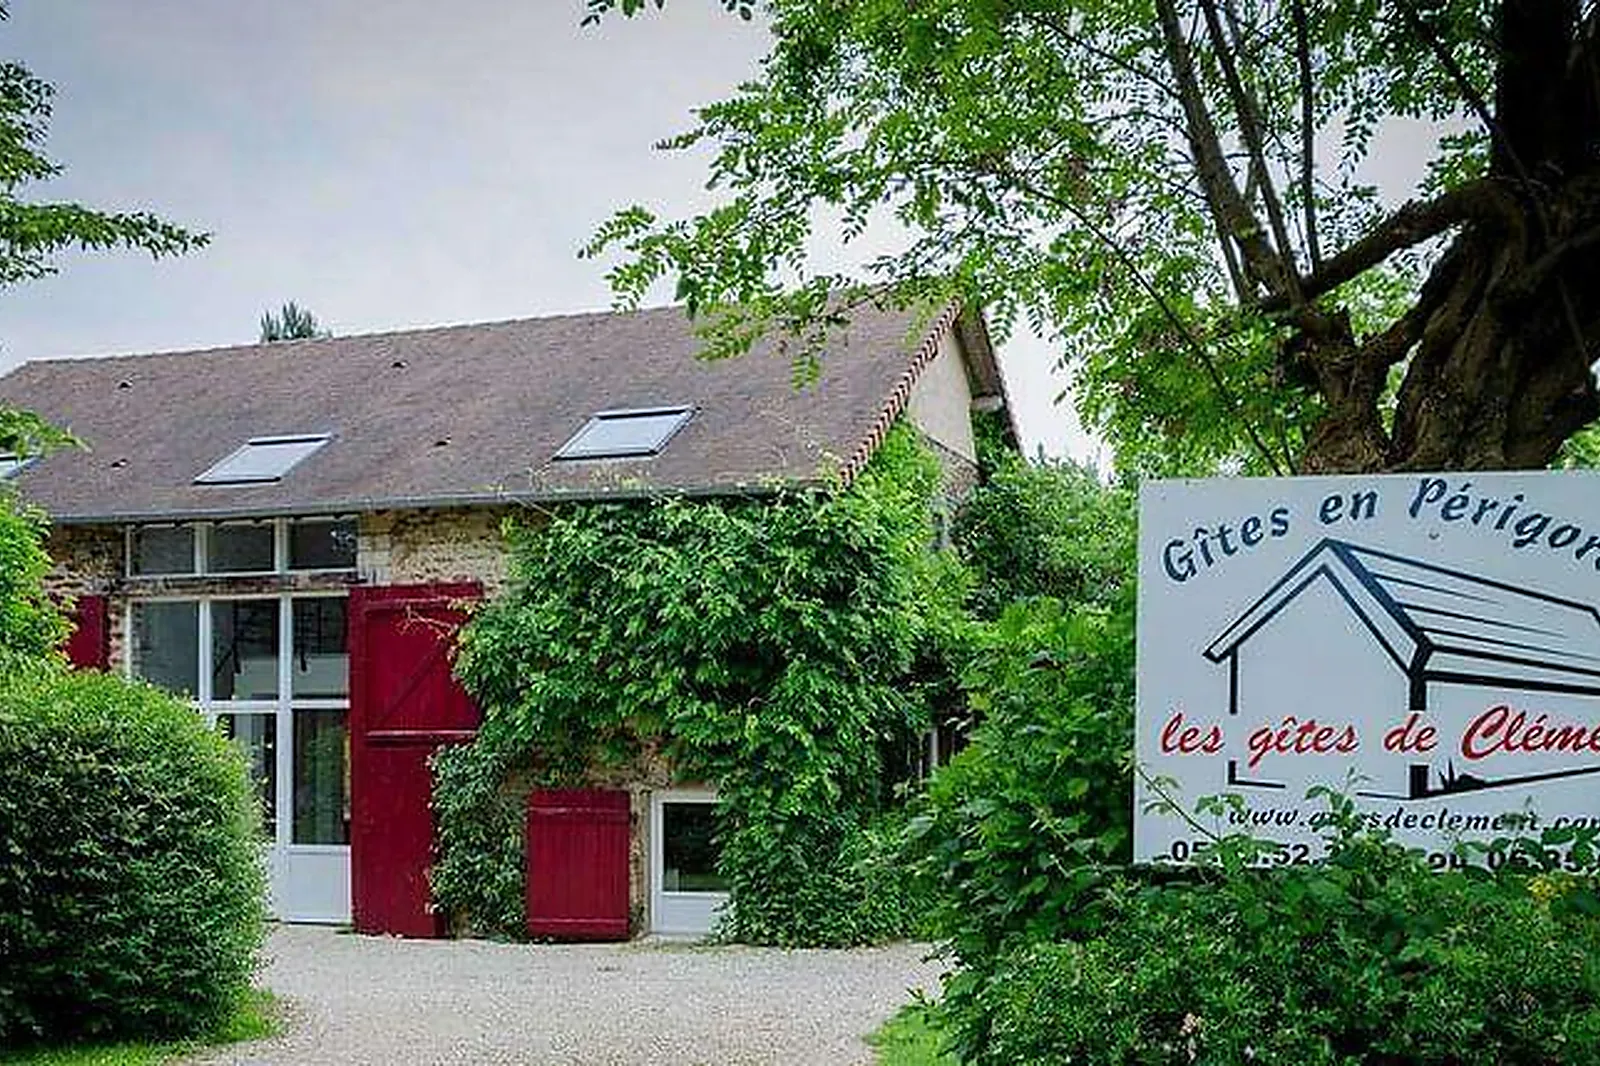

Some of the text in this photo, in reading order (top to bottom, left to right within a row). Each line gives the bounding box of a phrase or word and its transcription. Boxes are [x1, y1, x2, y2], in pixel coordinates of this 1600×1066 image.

[1163, 478, 1600, 582] Gîtes en Périgor
[1161, 713, 1225, 753] les
[1248, 715, 1359, 768] gîtes
[1384, 712, 1438, 752] de
